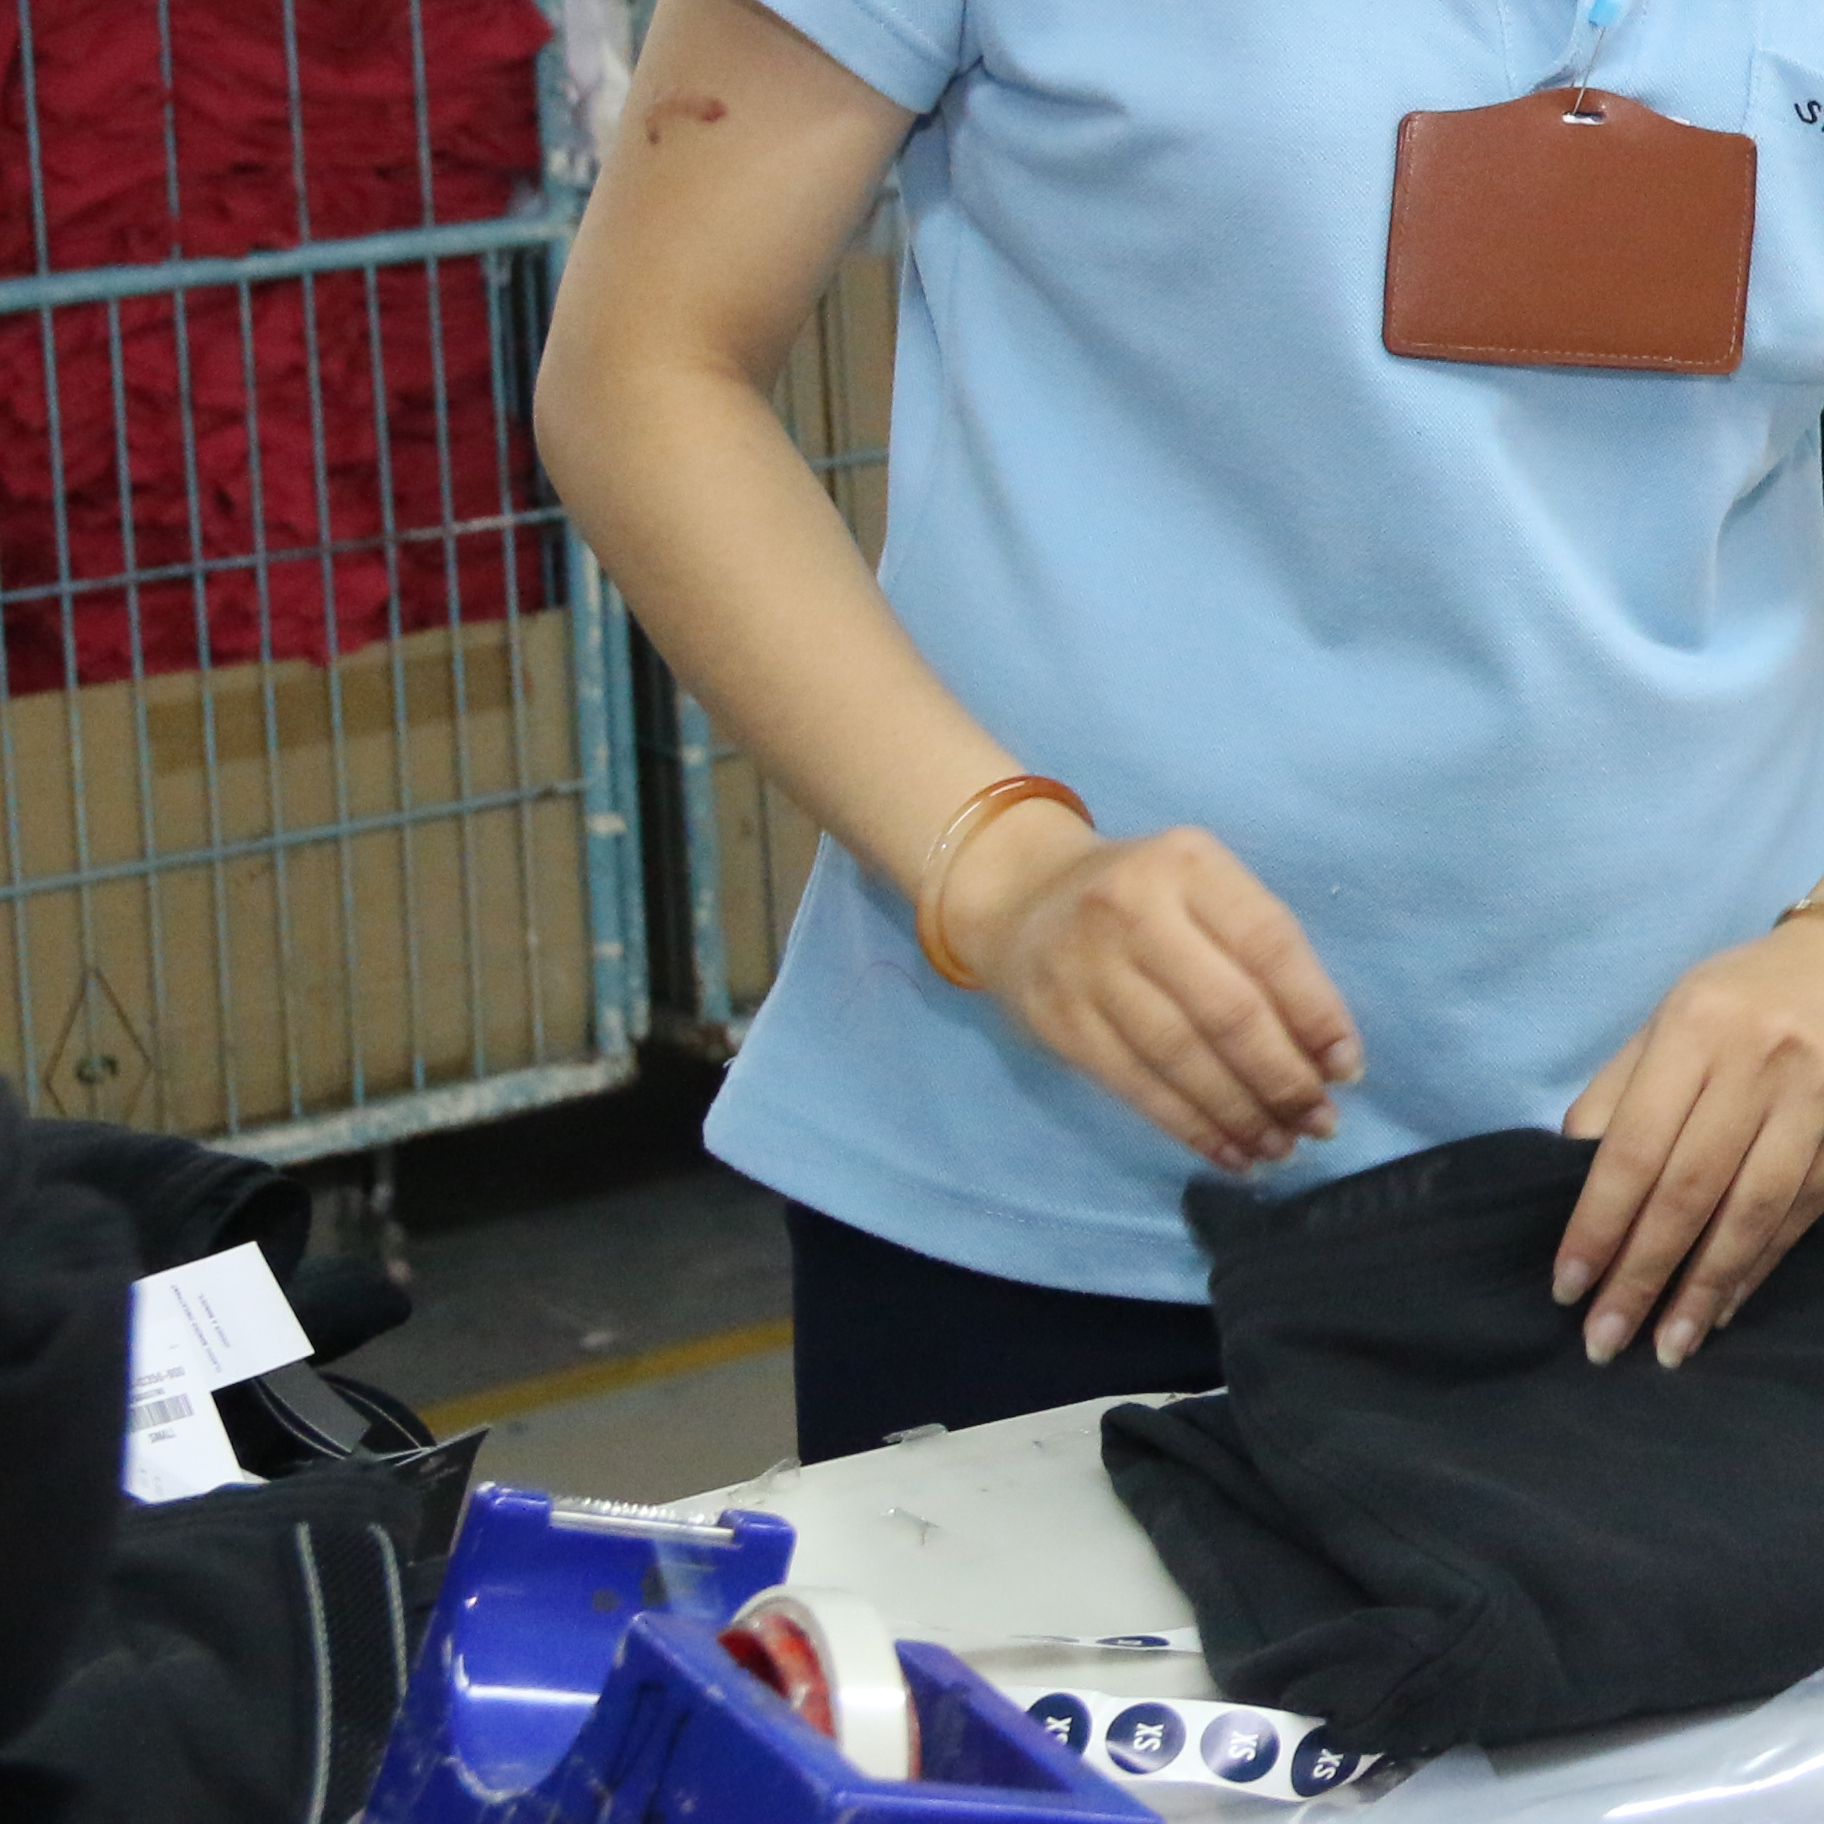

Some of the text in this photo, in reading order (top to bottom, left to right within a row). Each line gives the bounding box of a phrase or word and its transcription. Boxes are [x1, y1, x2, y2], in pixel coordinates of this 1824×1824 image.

[1134, 1722, 1164, 1751] XS
[1228, 1730, 1258, 1761] XS
[1313, 1748, 1345, 1780] XS
